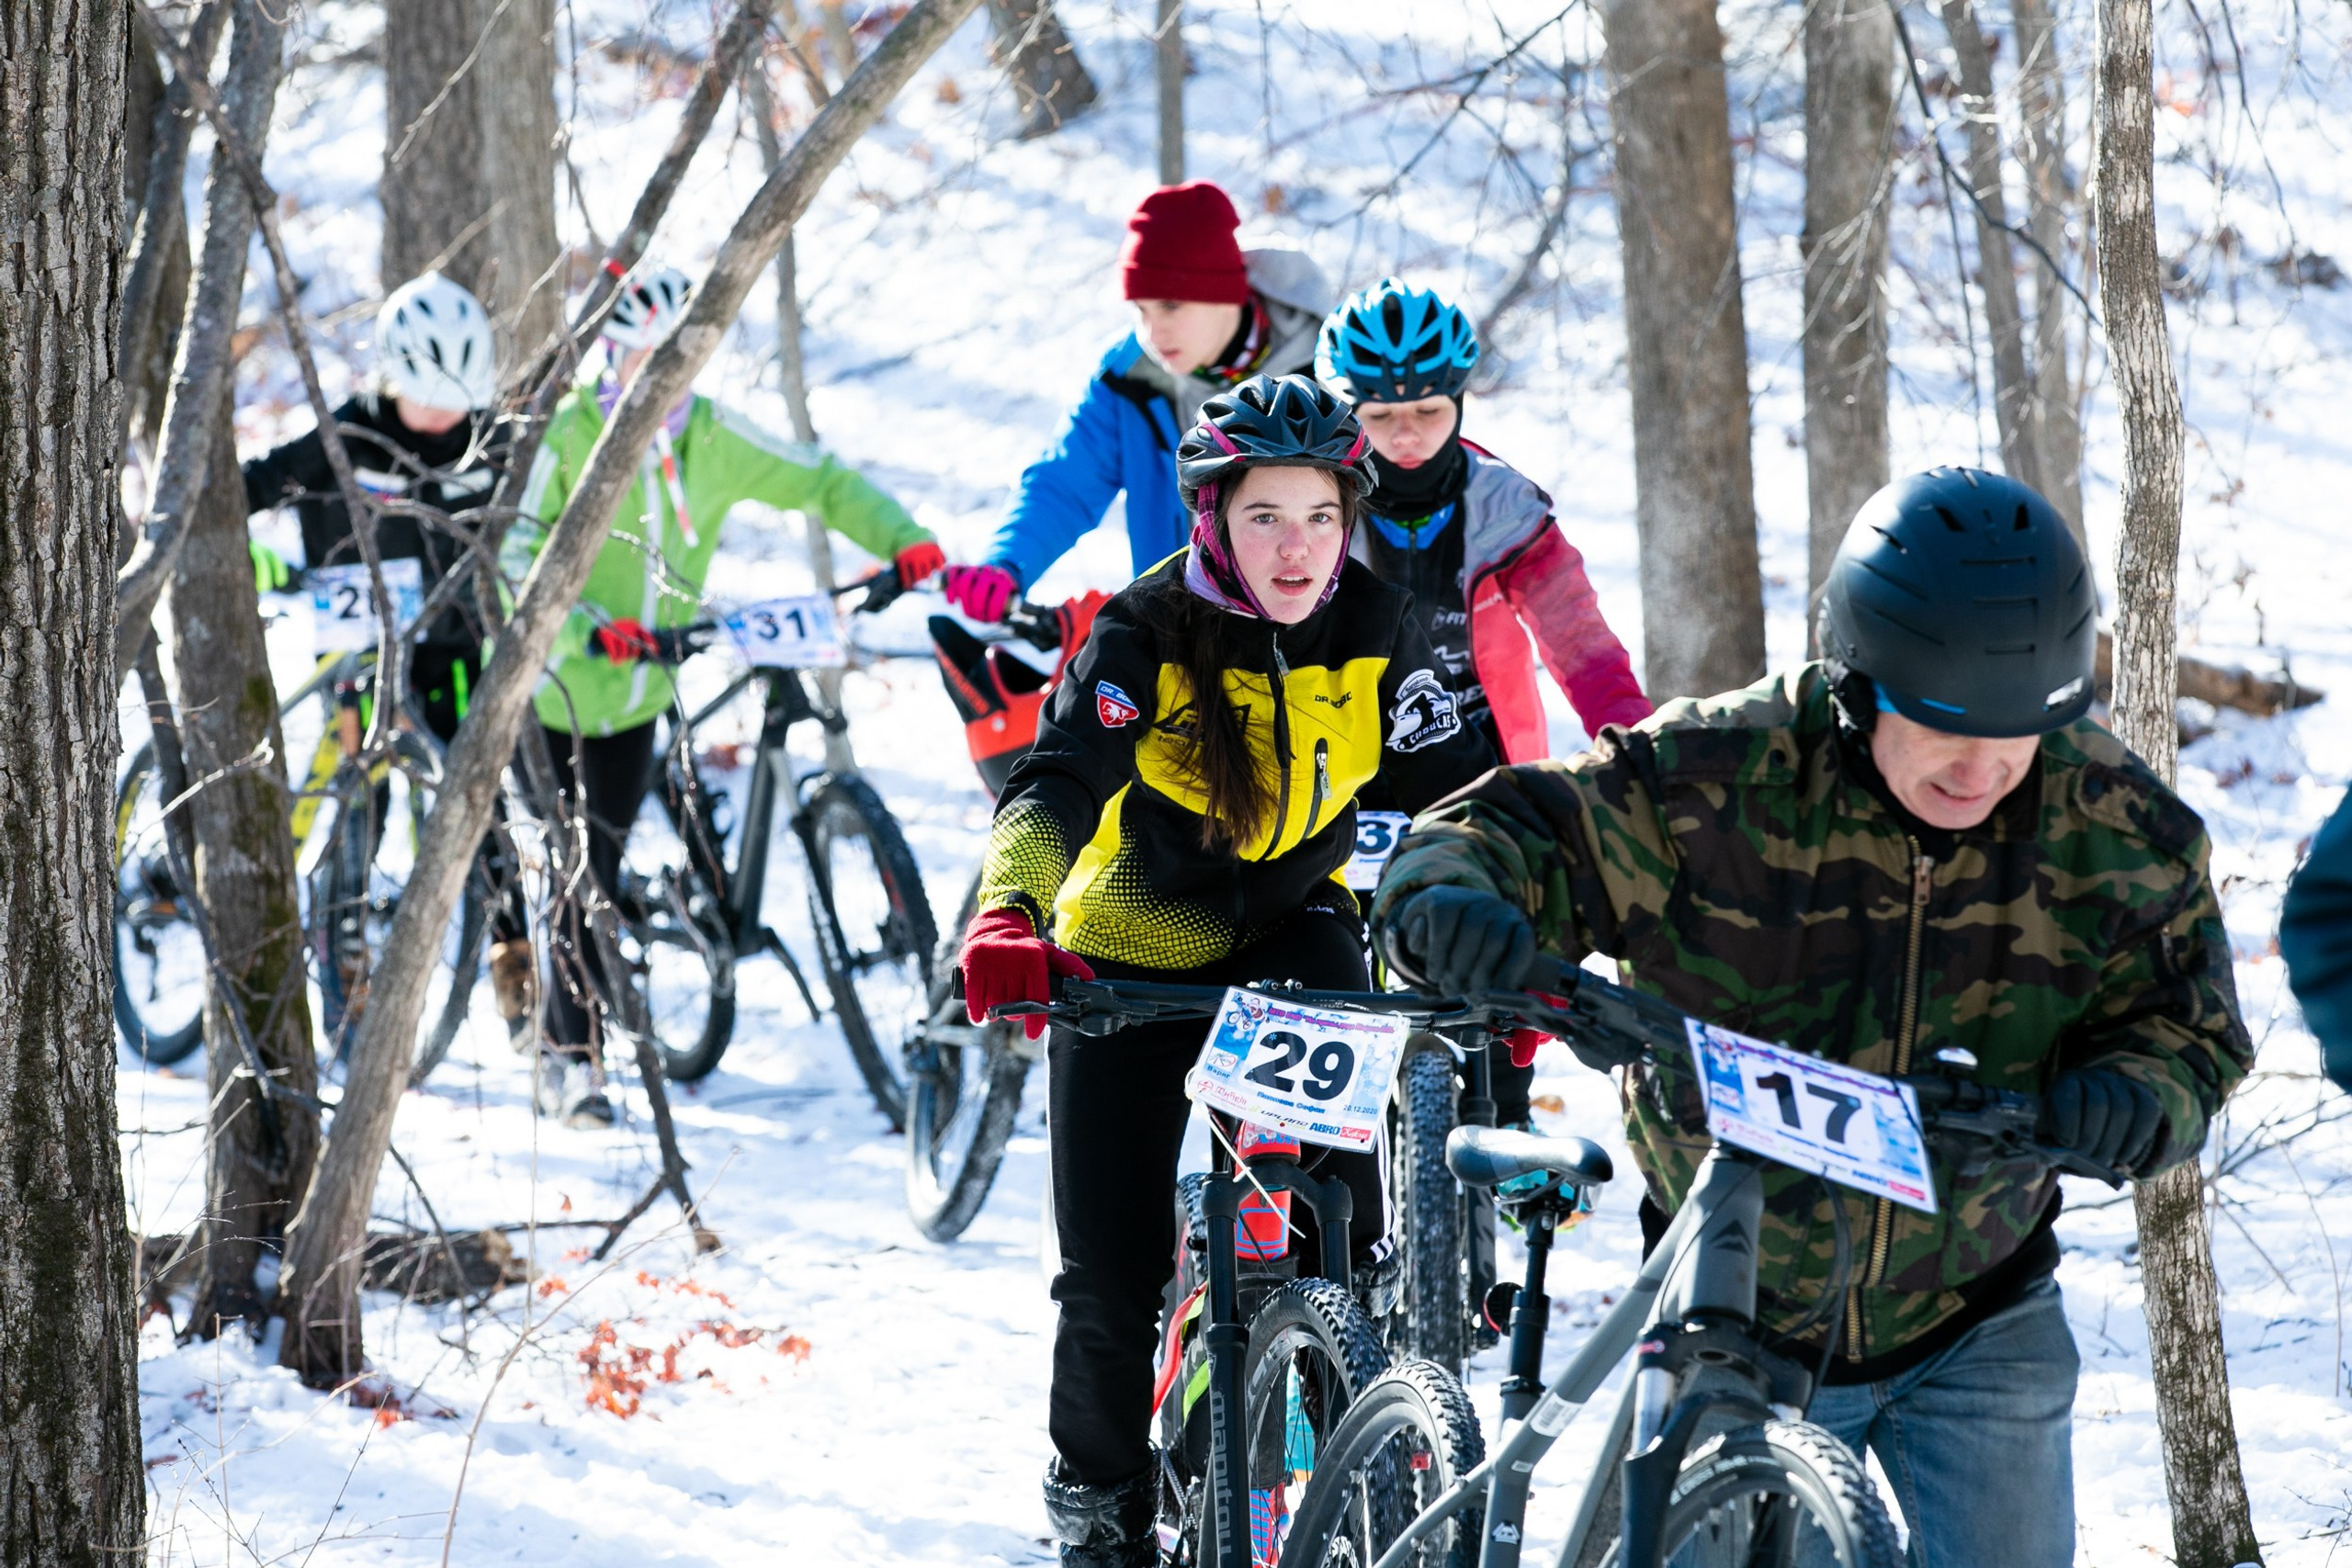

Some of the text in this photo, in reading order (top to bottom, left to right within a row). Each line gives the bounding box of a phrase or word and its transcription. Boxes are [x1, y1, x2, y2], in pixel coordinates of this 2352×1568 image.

[753, 607, 807, 640] 31
[1408, 715, 1452, 744] CHOUCAS
[1243, 1031, 1355, 1101] 29
[1343, 1104, 1378, 1115] 20.12.2020
[1756, 1071, 1861, 1145] 17
[1309, 1122, 1340, 1135] ABRO
[1212, 1387, 1233, 1555] manitou
